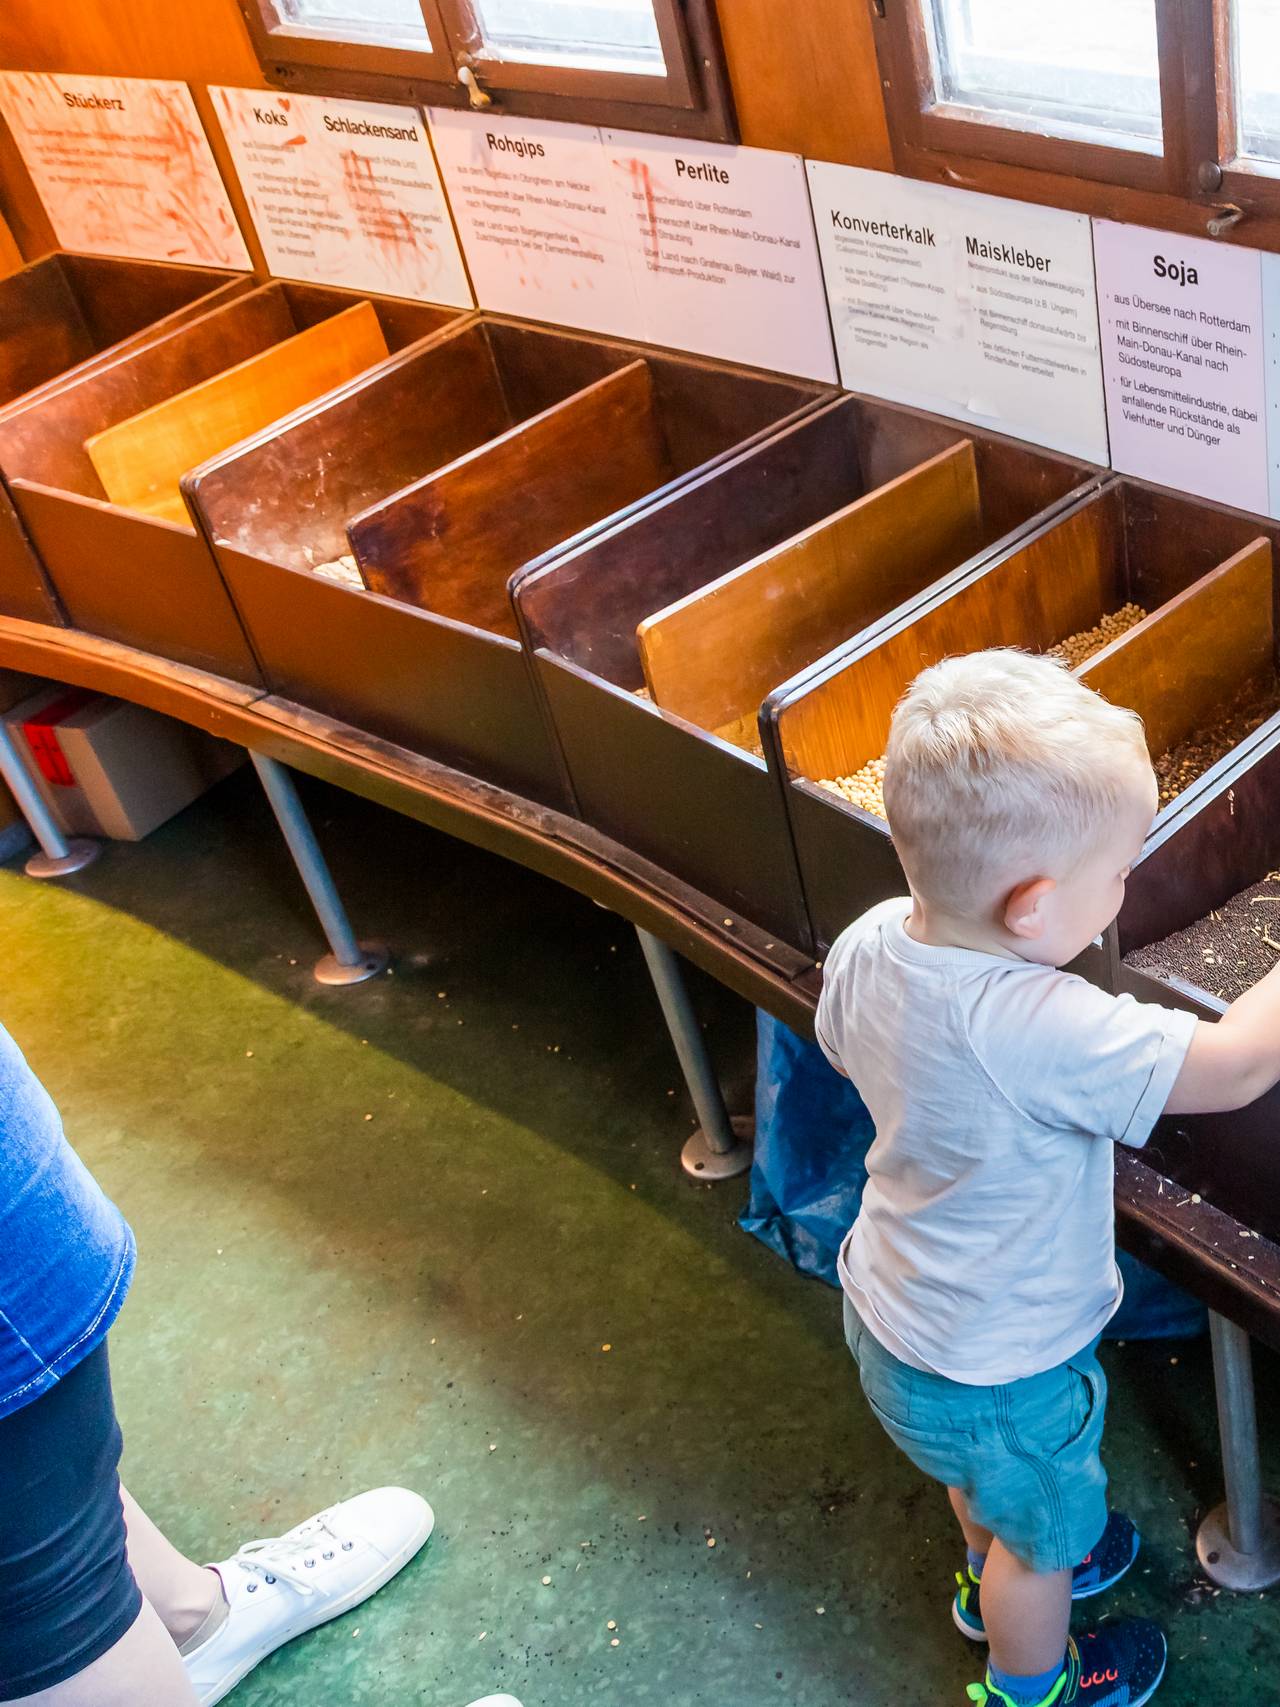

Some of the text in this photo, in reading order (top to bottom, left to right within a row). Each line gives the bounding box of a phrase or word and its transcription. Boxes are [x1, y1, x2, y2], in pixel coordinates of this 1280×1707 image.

[63, 92, 125, 111] Stückerz
[253, 108, 288, 127] Koks
[324, 115, 418, 142] Schlackensand
[486, 133, 545, 158] Rohgips
[675, 159, 729, 184] Perlite
[831, 209, 936, 247] Konverterkalk
[966, 236, 1051, 272] Maiskleber
[1153, 255, 1199, 286] Soja
[1114, 293, 1250, 333] aus Übersee nach Rotterdam
[1116, 320, 1129, 330] mit
[1133, 322, 1188, 344] Binnenschiff
[1192, 335, 1211, 350] über
[1117, 336, 1228, 372] Main-Donau-Kanal nach
[1119, 352, 1181, 377] Südosteuropa
[1121, 376, 1131, 388] für
[1232, 408, 1257, 421] dabei
[1122, 394, 1240, 434] anfallende Rückstände als
[1123, 409, 1220, 446] Viehfutter und Dünger
